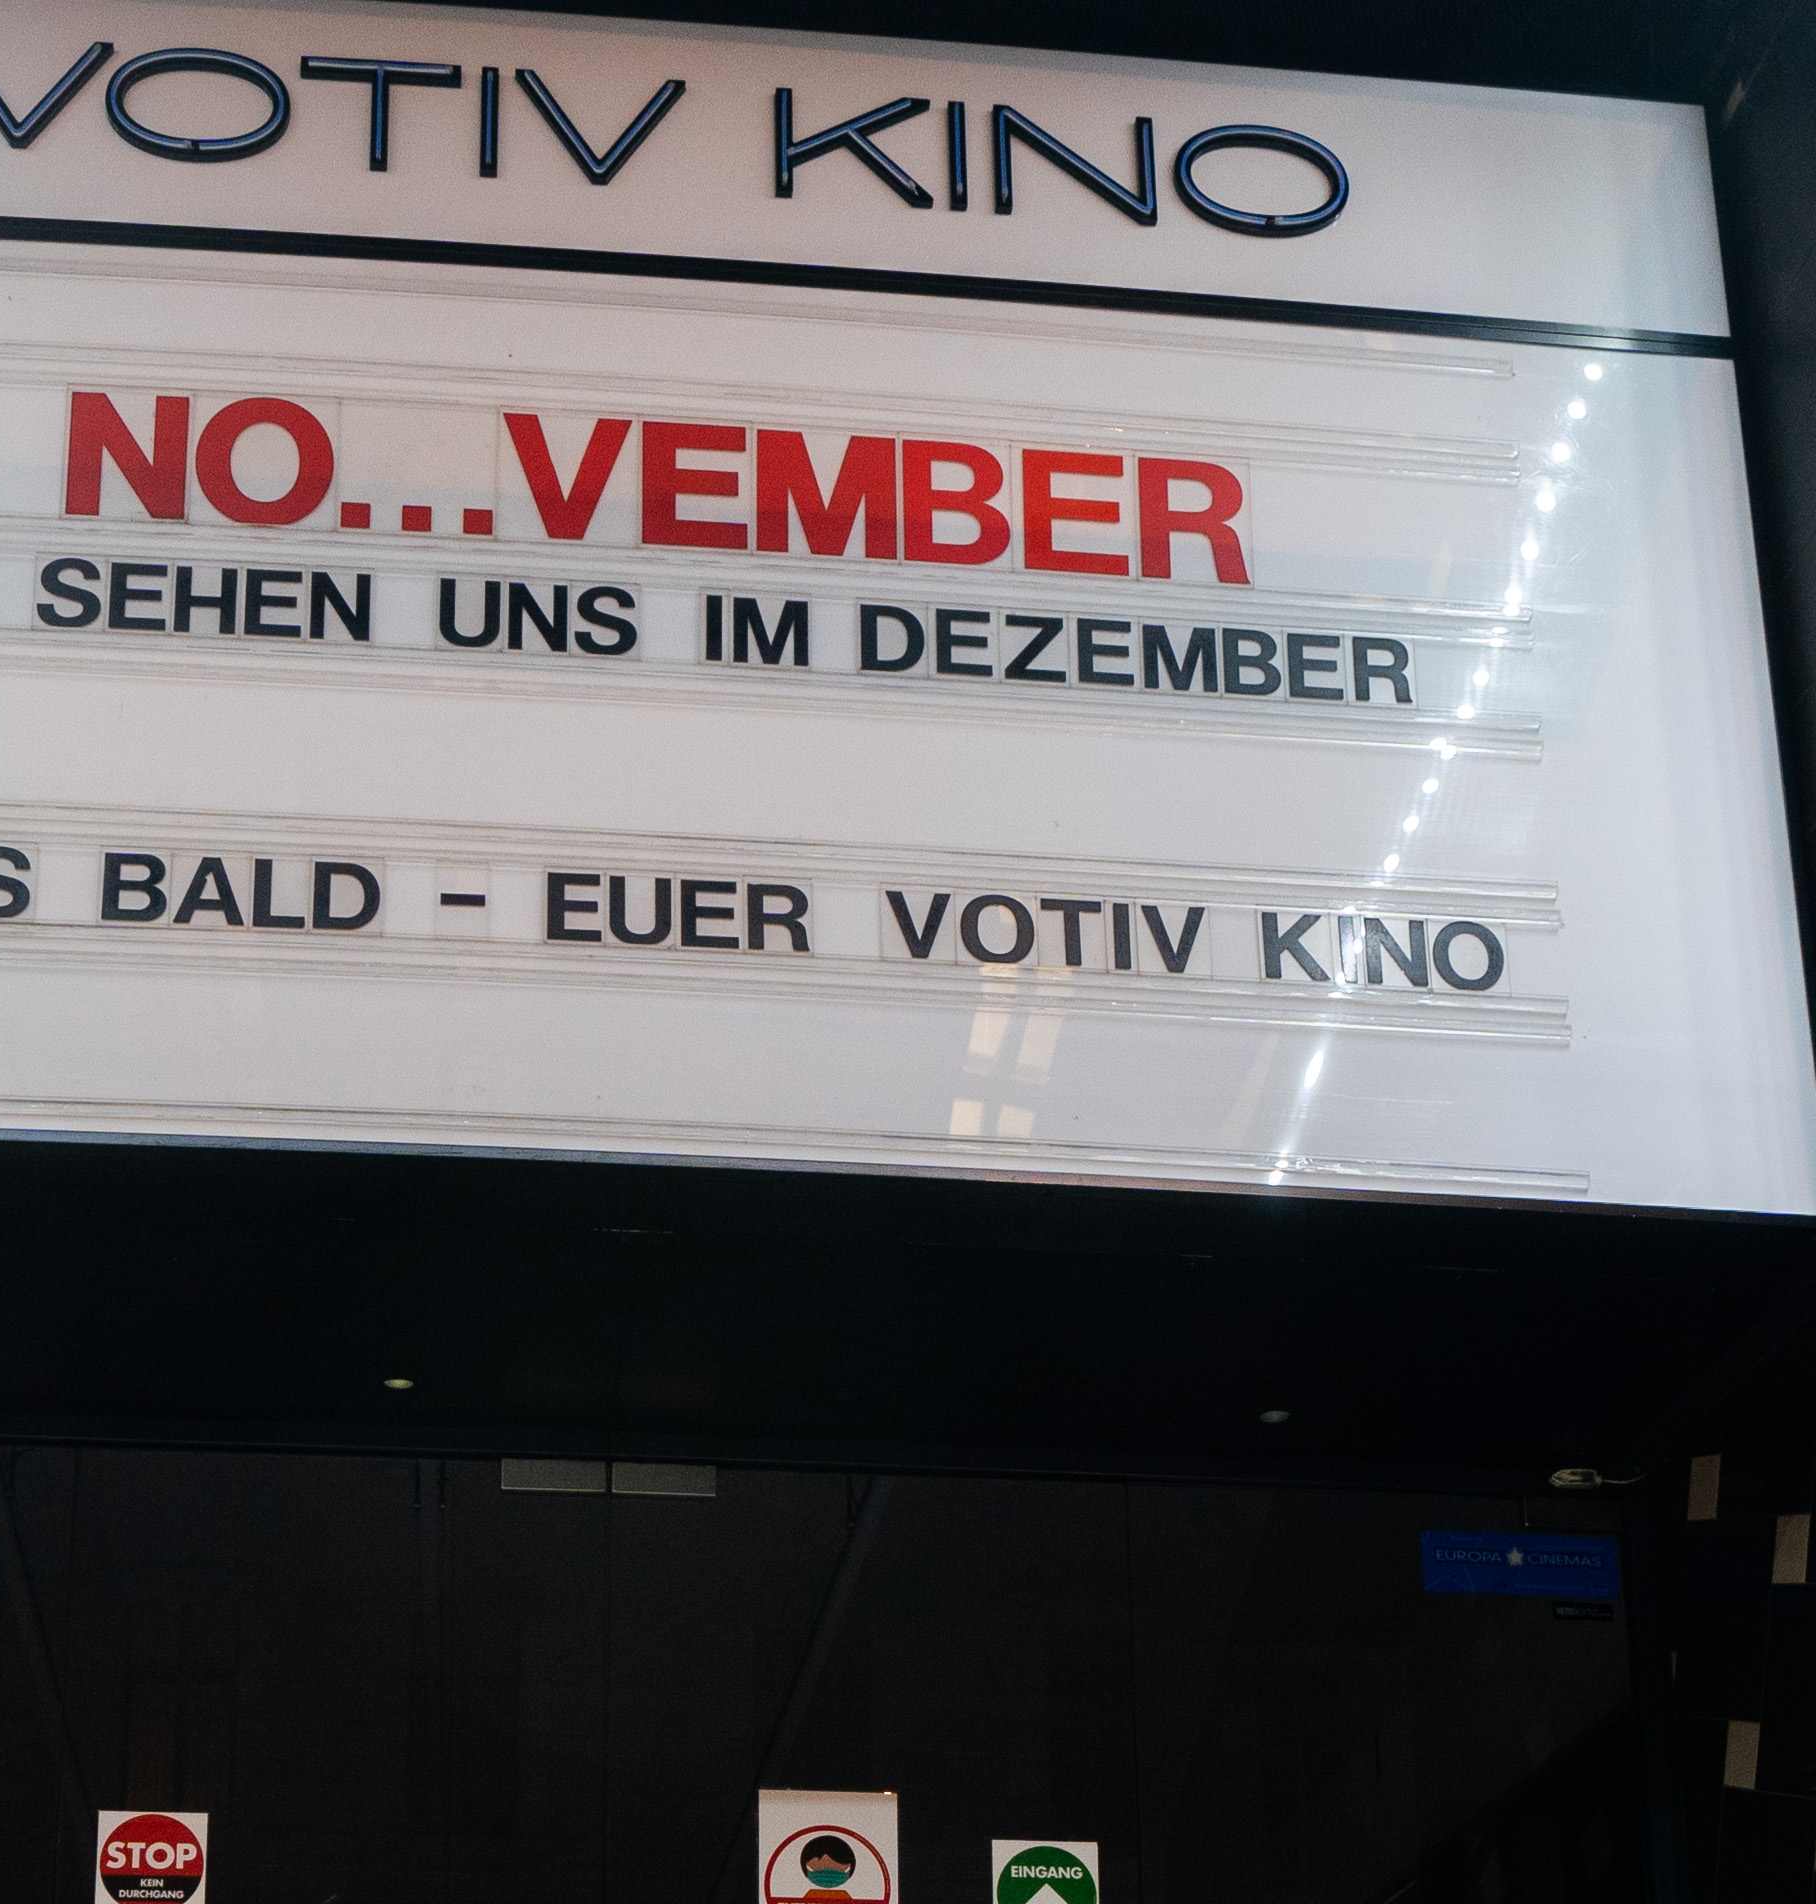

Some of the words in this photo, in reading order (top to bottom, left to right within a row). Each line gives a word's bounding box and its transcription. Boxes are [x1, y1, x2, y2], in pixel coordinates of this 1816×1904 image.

[775, 86, 1349, 238] KINO
[37, 557, 372, 642] SEHEN
[438, 578, 638, 656] UNS
[706, 594, 809, 667] IM
[859, 604, 1413, 704] DEZEMBER
[100, 852, 380, 930] BALD
[546, 871, 811, 953] EUER
[885, 889, 1205, 973] VOTIV
[1261, 910, 1504, 991] KINO
[106, 1841, 197, 1870] STOP
[140, 1878, 164, 1888] KEIN
[1010, 1864, 1083, 1880] EINGANG
[118, 1888, 184, 1900] DURCHGANG
